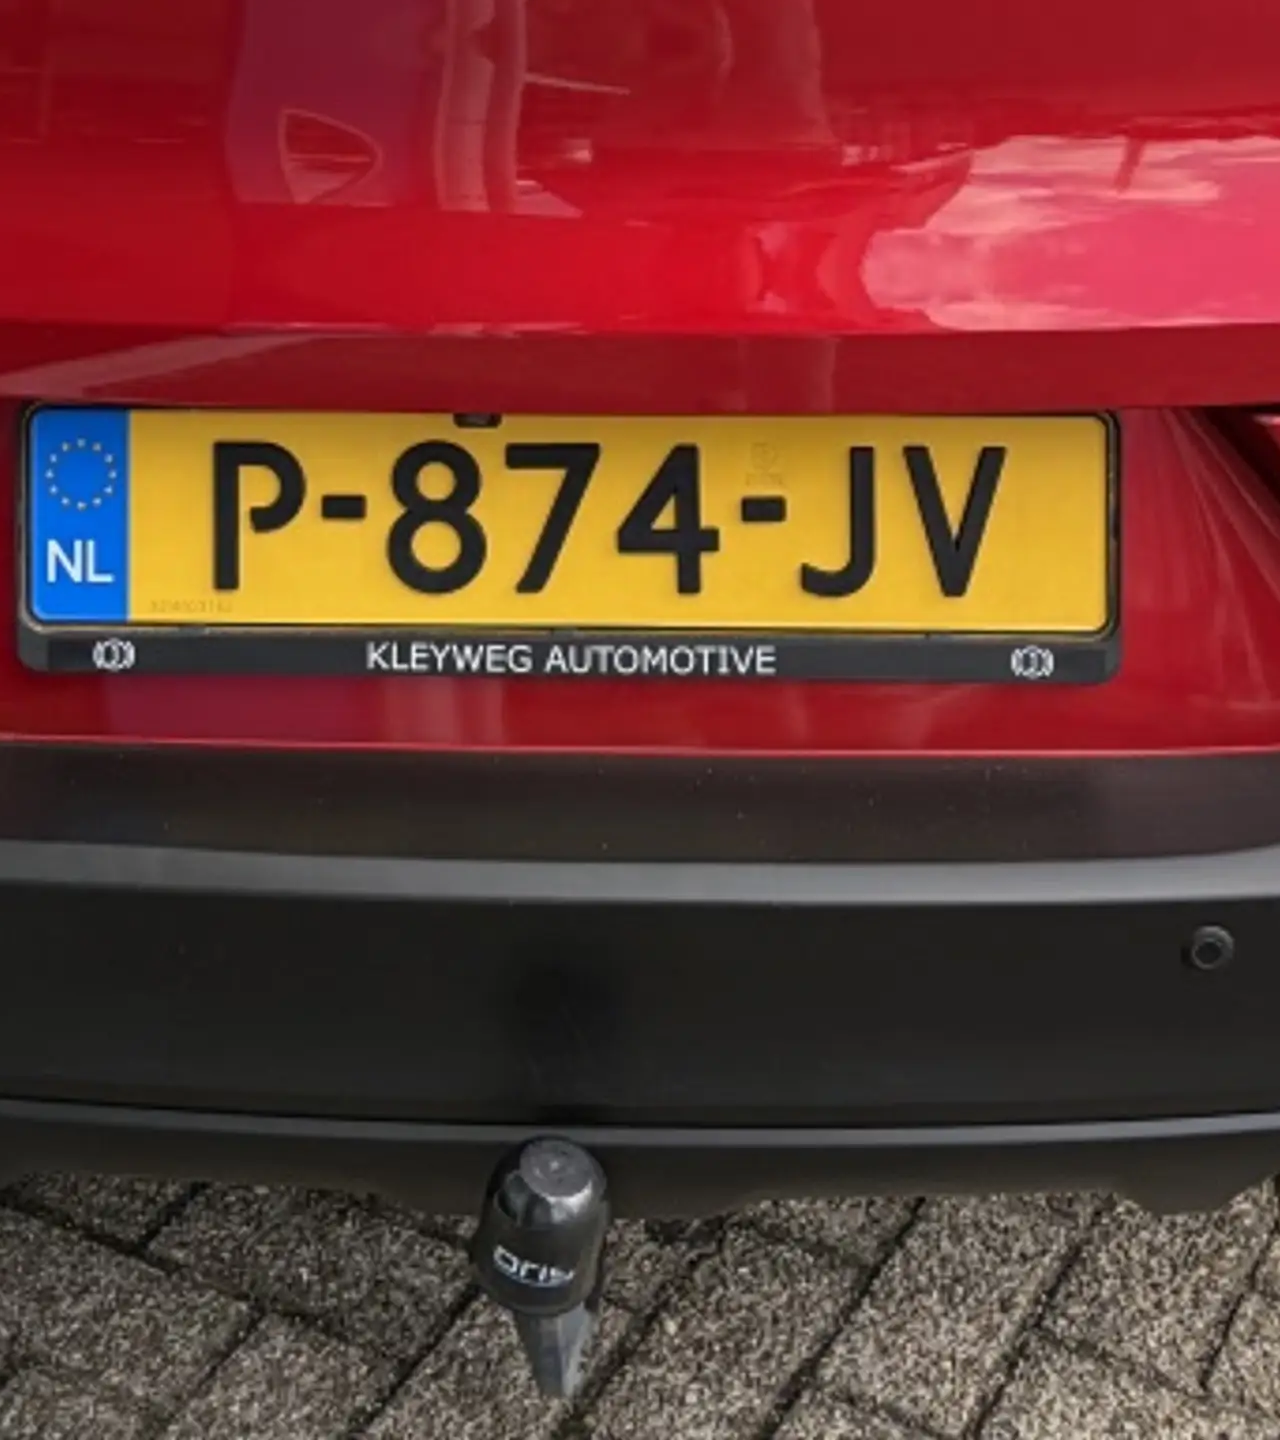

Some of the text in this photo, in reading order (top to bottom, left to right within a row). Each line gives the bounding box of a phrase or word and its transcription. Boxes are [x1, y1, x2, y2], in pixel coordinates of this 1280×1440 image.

[212, 440, 1008, 599] P-874-JV
[46, 540, 114, 584] NL
[366, 640, 777, 677] KLEYWEG AUTOMOTIVE
